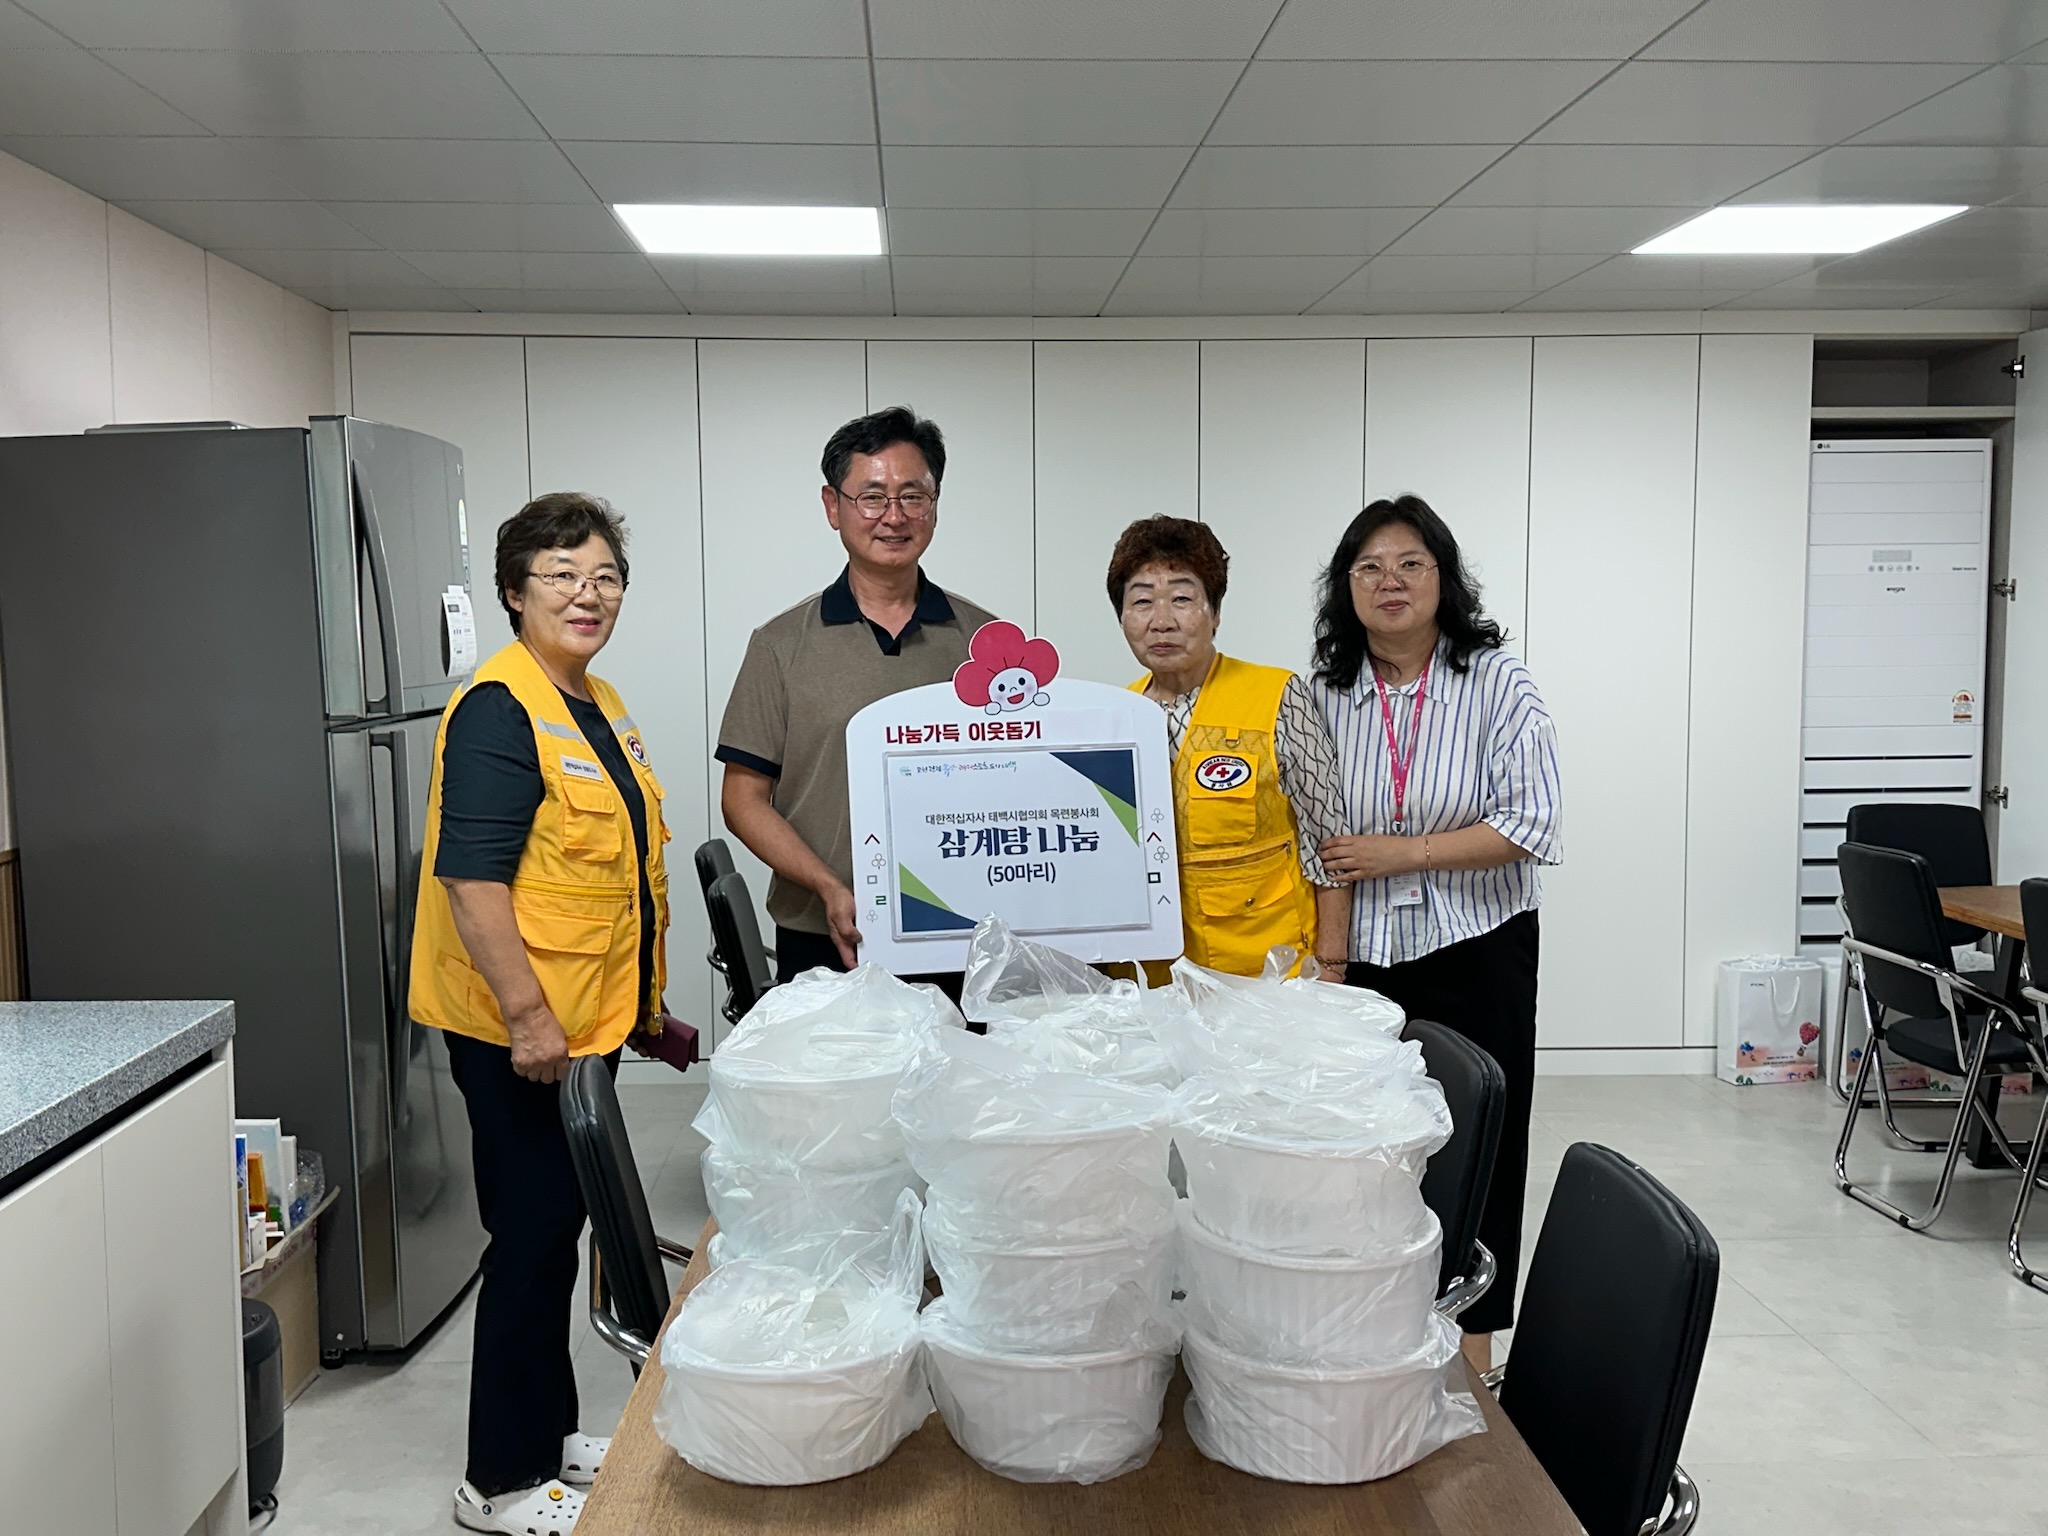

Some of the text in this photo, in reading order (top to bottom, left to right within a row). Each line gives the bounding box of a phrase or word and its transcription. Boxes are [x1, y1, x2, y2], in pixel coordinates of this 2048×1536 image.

[886, 720, 1041, 744] 나눔가득 이웃돕기
[925, 807, 1100, 826] 대한적십자사 태백시협의회 목련봉사회
[937, 823, 1100, 859] 삼계탕 나눔
[987, 861, 1057, 887] (50마리)
